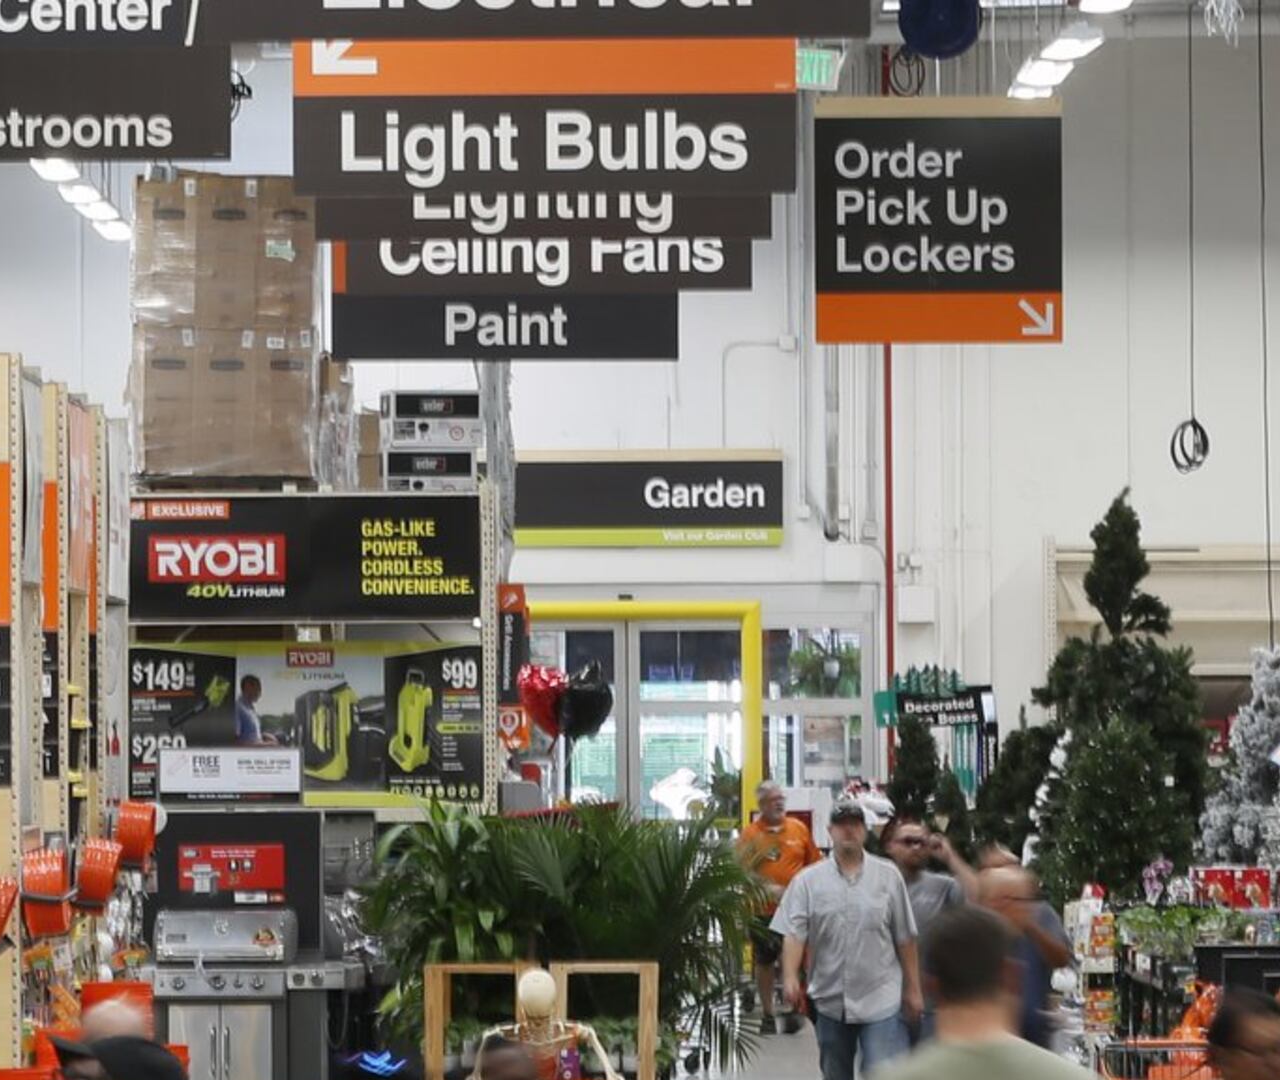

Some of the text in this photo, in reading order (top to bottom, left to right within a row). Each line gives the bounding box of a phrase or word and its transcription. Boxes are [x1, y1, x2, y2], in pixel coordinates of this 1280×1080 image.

[797, 52, 832, 85] XIT
[340, 109, 749, 188] Light Bulbs
[834, 141, 963, 179] Order
[835, 188, 1009, 233] Pick Up
[378, 238, 725, 288] Ceiling Fans
[835, 236, 1016, 273] Lockers
[443, 303, 568, 346] Paint
[643, 476, 766, 509] Garden
[151, 503, 225, 517] EXCLUSIVE
[360, 519, 436, 537] GAS-LIKE
[154, 540, 276, 577] RYOBI
[361, 539, 424, 557] POWER.
[361, 559, 444, 577] CORDLESS
[361, 578, 475, 596] CONVENIENCE.
[288, 651, 332, 666] RYOBI
[441, 658, 478, 690] $99
[904, 697, 975, 714] Decorated
